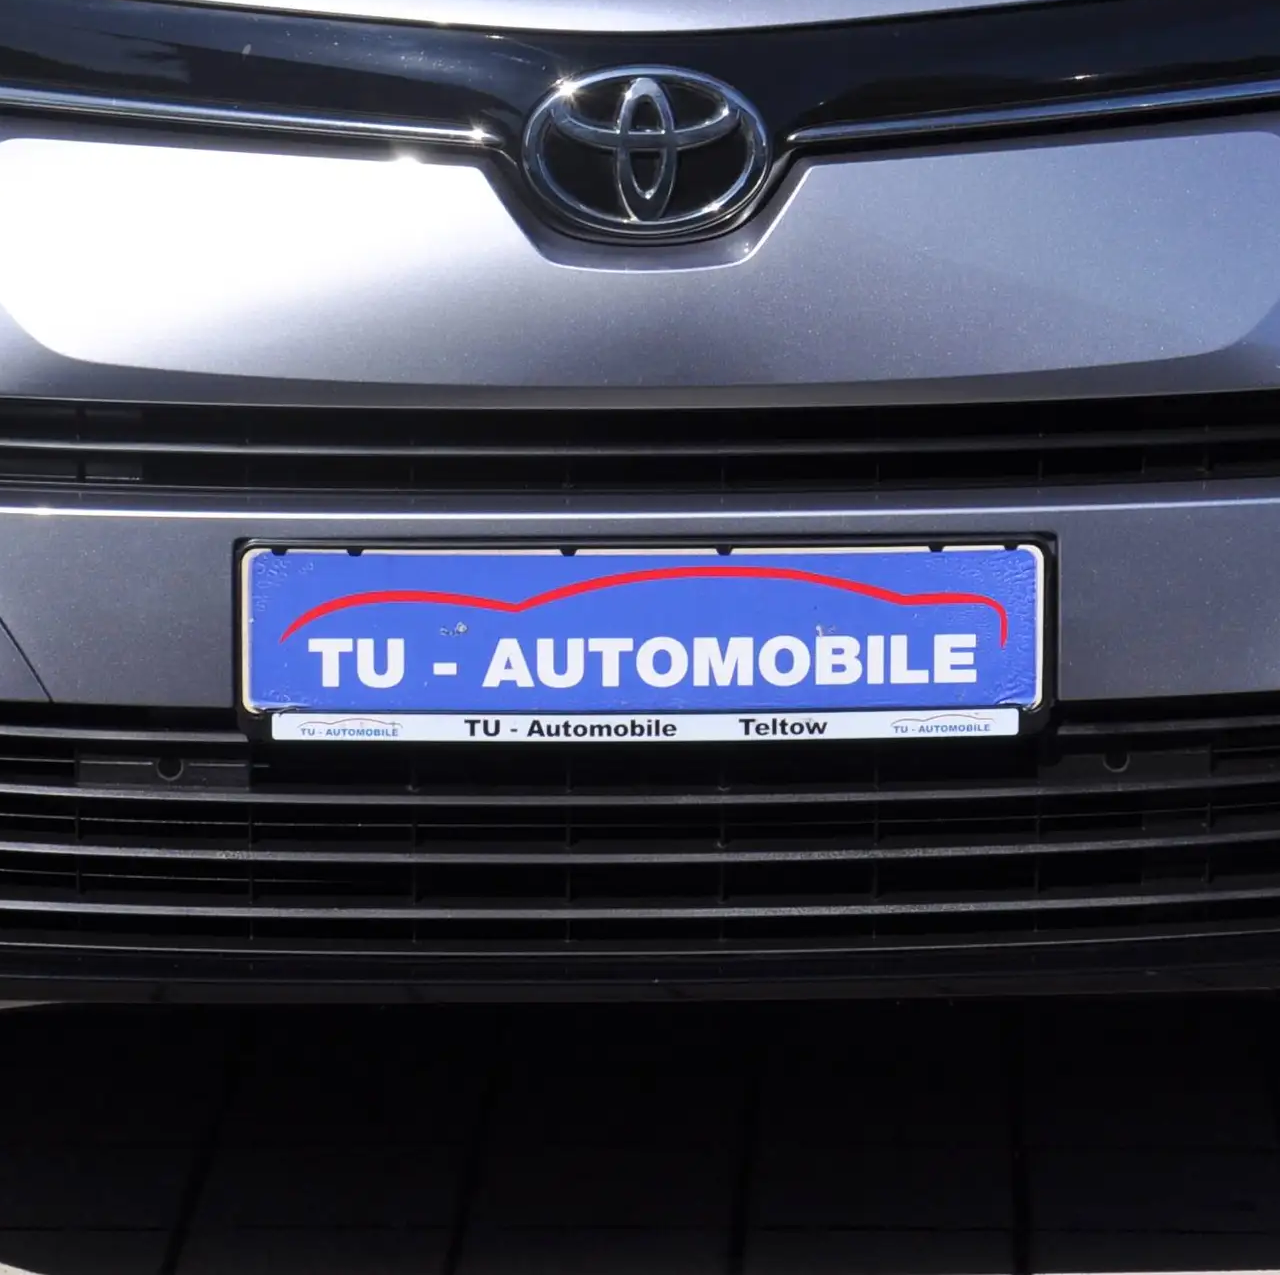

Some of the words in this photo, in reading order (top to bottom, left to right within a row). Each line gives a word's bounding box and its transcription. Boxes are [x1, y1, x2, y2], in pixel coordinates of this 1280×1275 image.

[308, 637, 405, 689] TU
[482, 633, 978, 689] AUTOMOBILE
[300, 728, 316, 737] TU
[326, 727, 399, 737] AUTOMOBILE
[464, 719, 501, 737] TU
[526, 719, 678, 737] Automobile
[738, 717, 829, 736] Teltow
[893, 724, 909, 734] TU
[918, 723, 991, 733] AUTOMOBILE
